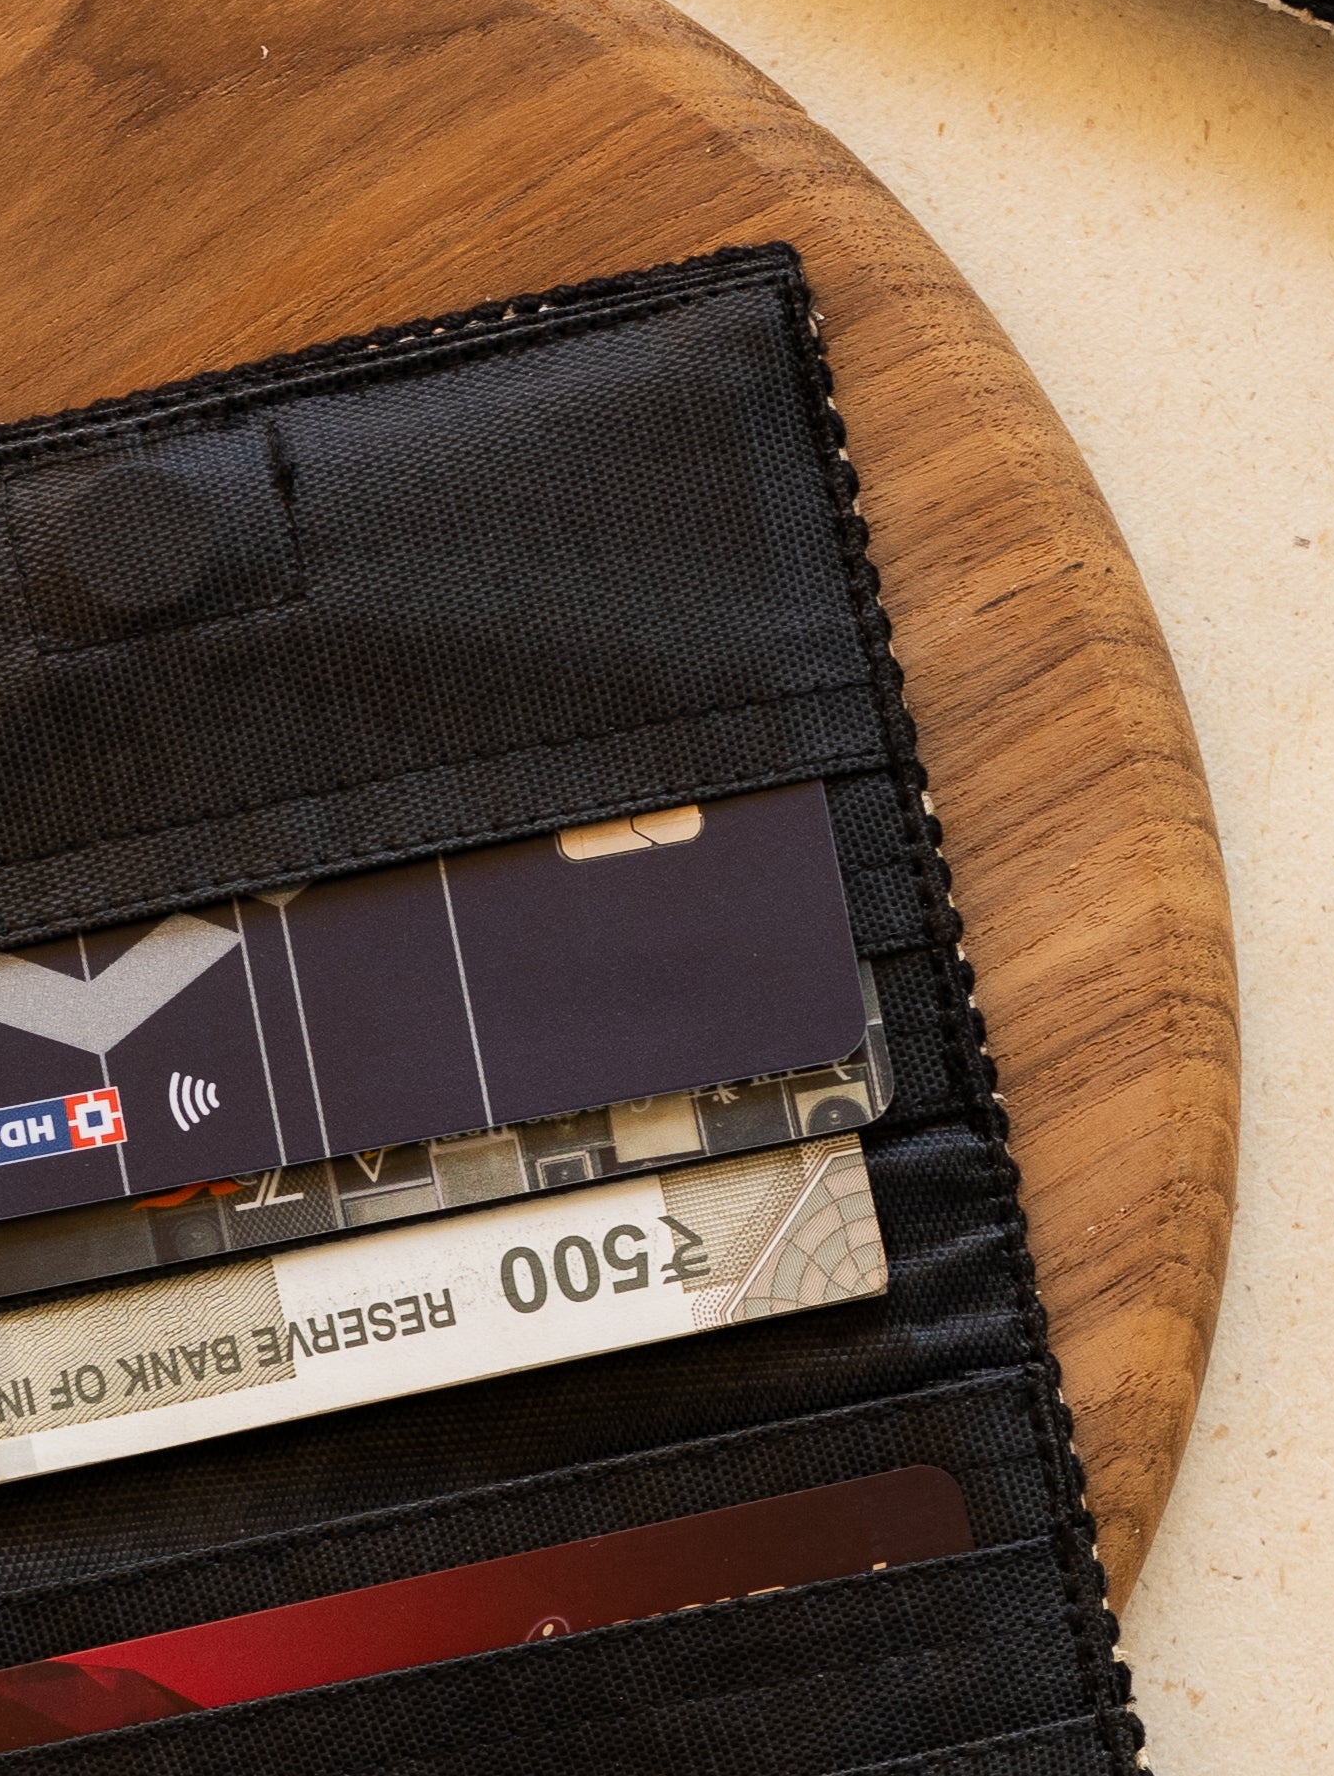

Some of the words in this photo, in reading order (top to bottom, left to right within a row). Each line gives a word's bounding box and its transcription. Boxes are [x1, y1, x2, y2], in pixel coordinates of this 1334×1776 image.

[500, 1214, 712, 1313] ₹500
[251, 1287, 457, 1368] RESERVE
[50, 1364, 108, 1412] OF
[116, 1335, 244, 1397] BANK
